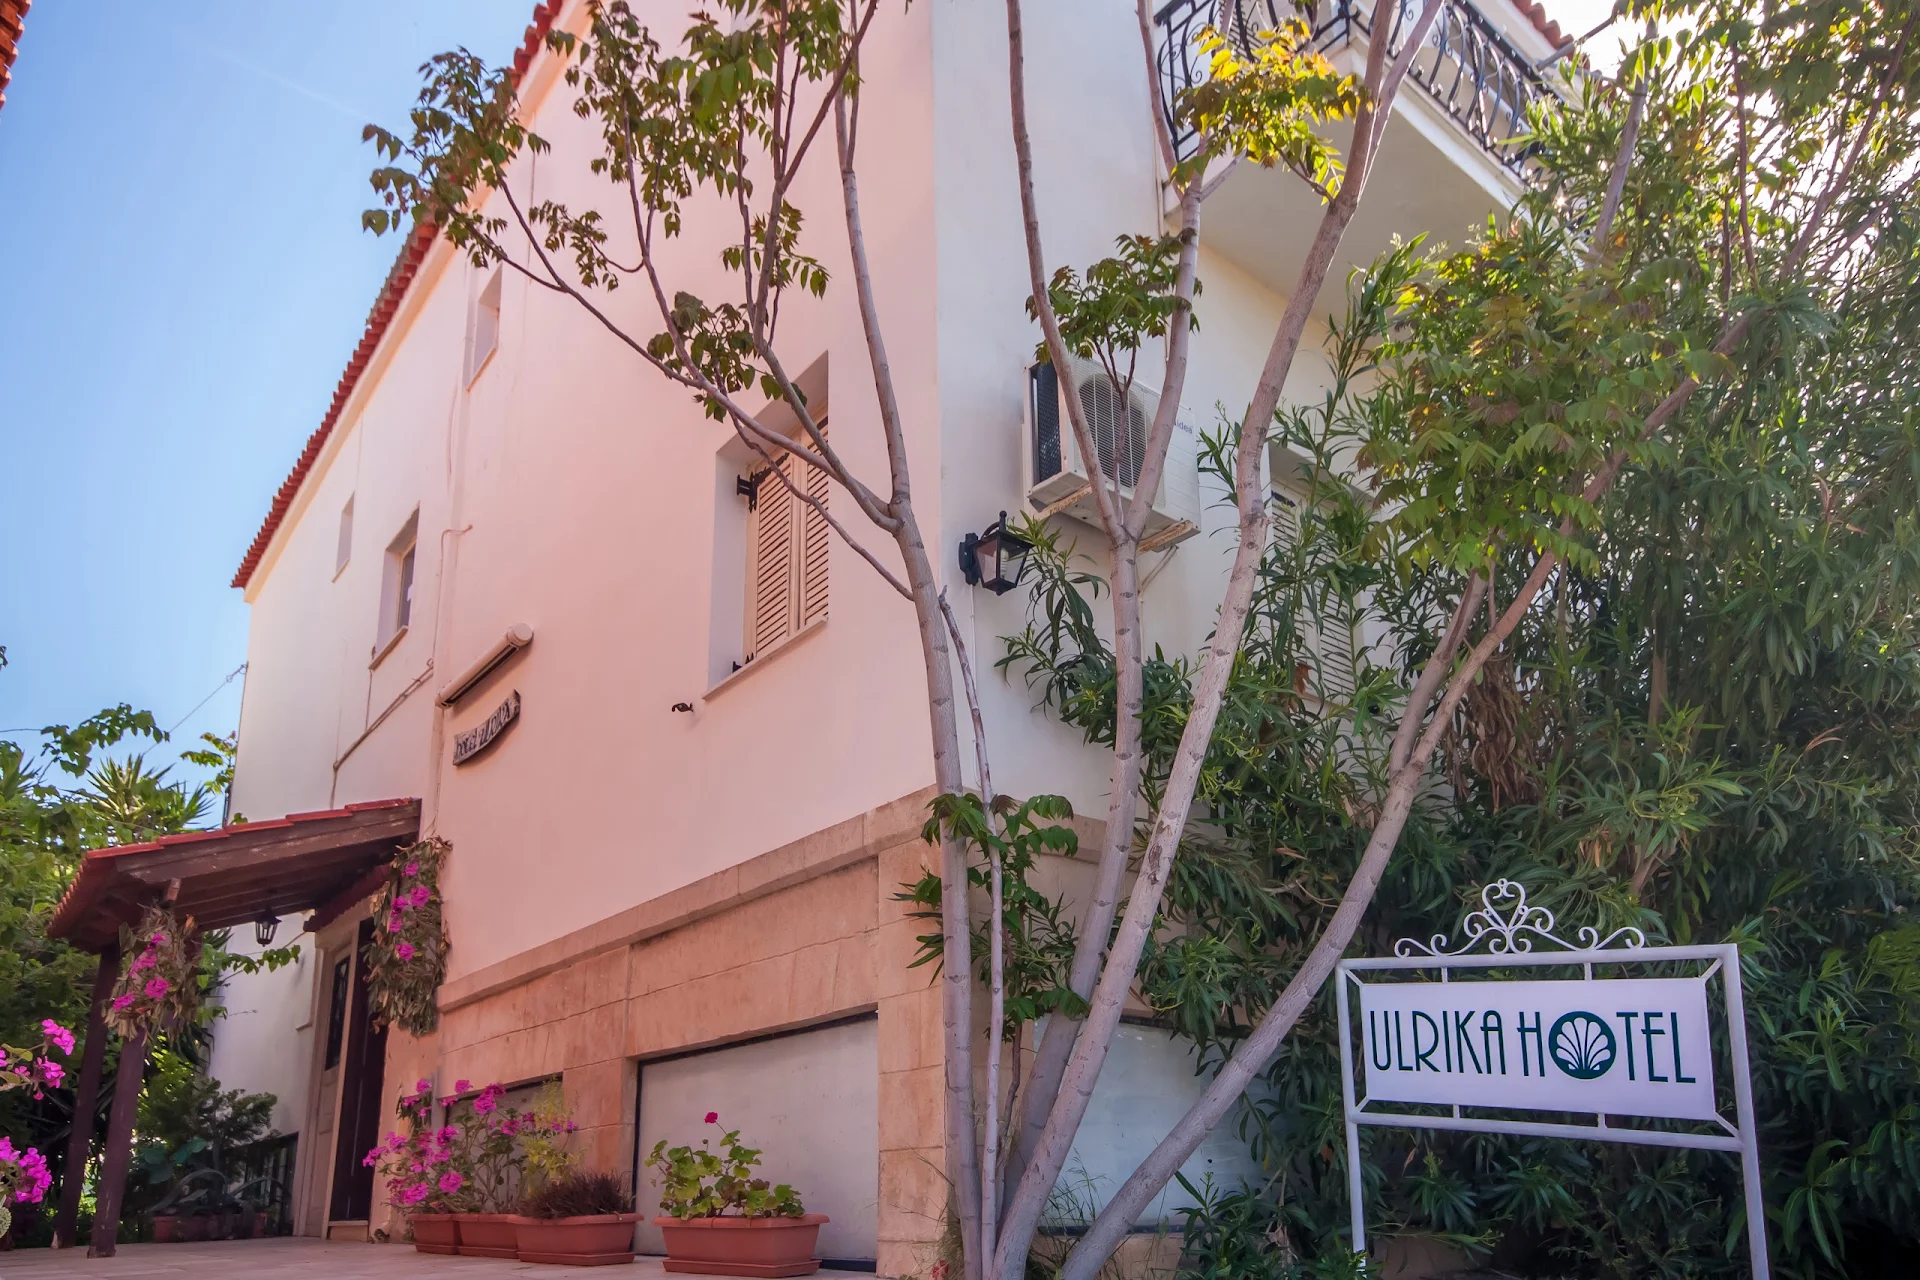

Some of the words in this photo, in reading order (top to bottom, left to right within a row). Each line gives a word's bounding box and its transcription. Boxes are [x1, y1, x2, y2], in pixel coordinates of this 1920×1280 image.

[1173, 418, 1193, 434] idea
[1369, 1009, 1507, 1076] ULRIKA
[1516, 1010, 1697, 1084] HOTEL
